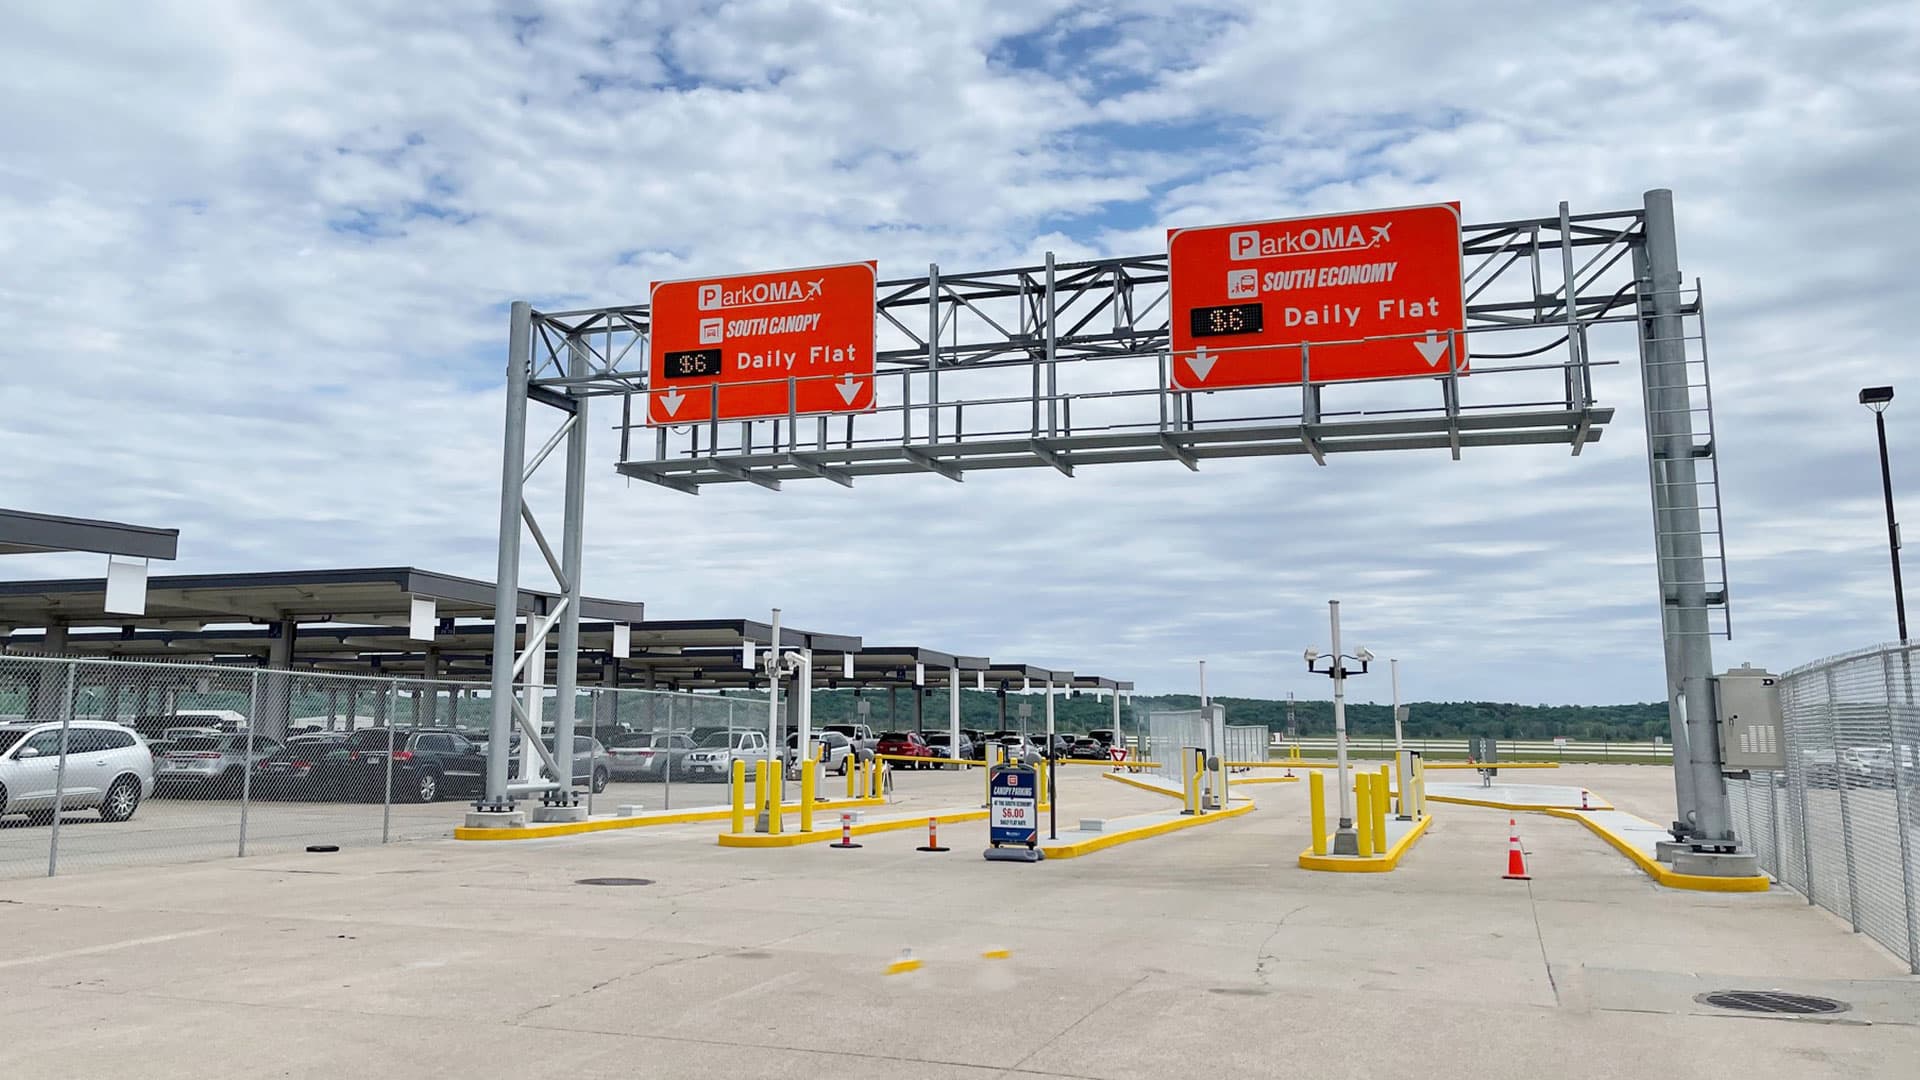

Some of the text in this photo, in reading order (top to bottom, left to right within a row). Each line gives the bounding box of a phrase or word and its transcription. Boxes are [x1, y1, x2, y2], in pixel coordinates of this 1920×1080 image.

[1237, 224, 1366, 257] ParkOMA
[1262, 261, 1398, 292] SOUTH ECONOMY
[703, 280, 803, 306] ParkOMA
[1210, 308, 1243, 332] $6
[1284, 296, 1439, 327] Daily Flat
[726, 313, 822, 338] SOUTH CANOPY
[679, 353, 707, 374] $6
[737, 344, 856, 370] Daily Flat
[993, 787, 1032, 796] CANOPY PARKING
[1002, 808, 1024, 818] $6.00
